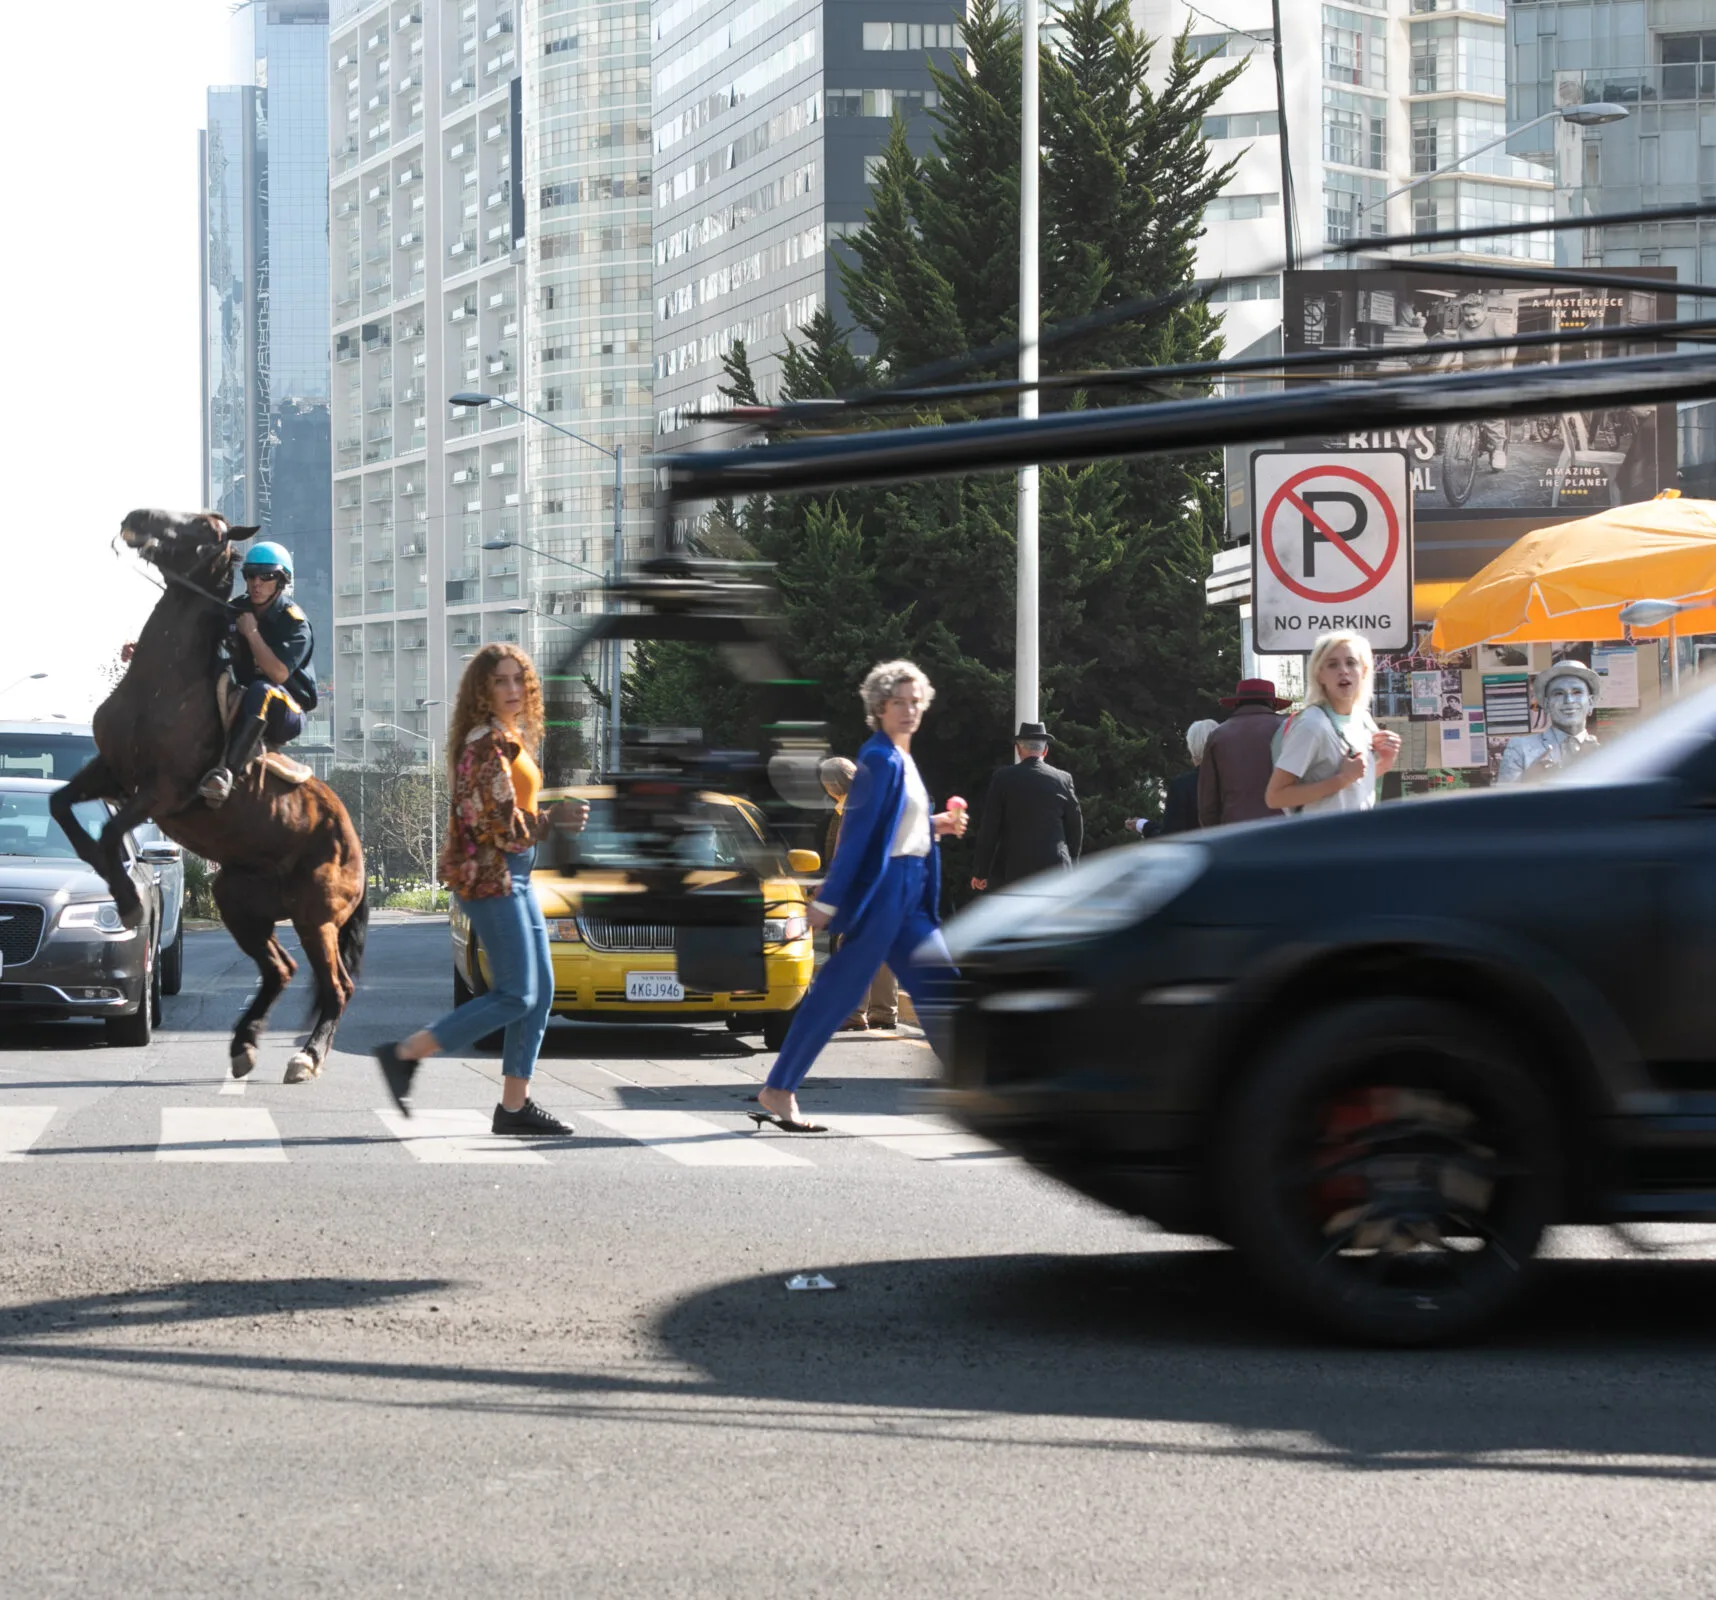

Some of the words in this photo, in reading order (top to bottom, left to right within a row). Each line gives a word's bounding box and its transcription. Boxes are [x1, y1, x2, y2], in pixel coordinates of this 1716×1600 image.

[1532, 299, 1540, 308] A
[1544, 298, 1624, 307] MASTERPIECE
[1572, 309, 1605, 318] NEWS
[1546, 467, 1601, 476] AMAZING
[1539, 479, 1560, 487] THE
[1565, 478, 1608, 487] PLANET
[1302, 491, 1368, 577] P
[1274, 615, 1302, 631] NO
[1308, 614, 1392, 630] PARKING
[630, 983, 680, 997] 4KGJ946
